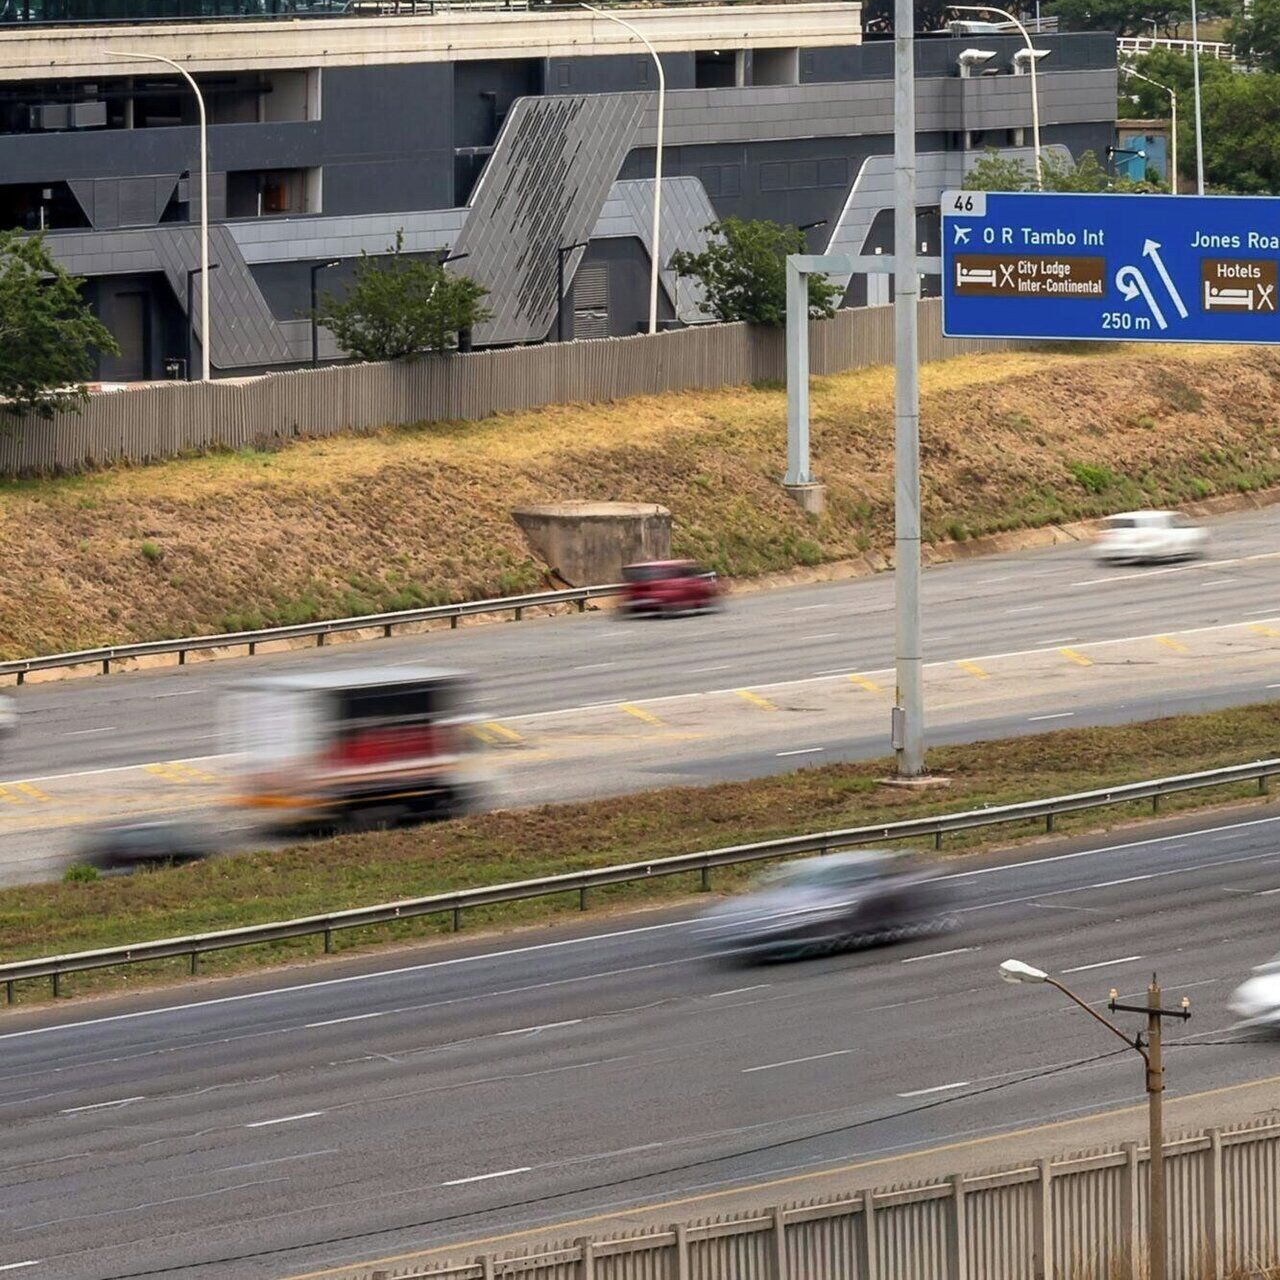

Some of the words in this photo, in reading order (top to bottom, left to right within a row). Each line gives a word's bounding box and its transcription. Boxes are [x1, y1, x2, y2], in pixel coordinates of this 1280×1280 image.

[953, 194, 973, 212] 46
[983, 228, 995, 245] O
[1002, 228, 1013, 245] R
[1021, 228, 1076, 246] Tambo
[1083, 229, 1105, 246] Int
[1191, 231, 1241, 249] Jones
[1017, 260, 1038, 278] City
[1040, 261, 1072, 278] Lodge
[1216, 263, 1261, 279] Hotels
[1017, 278, 1103, 295] Inter-Continental
[1101, 313, 1132, 330] 250
[1135, 317, 1151, 330] m
